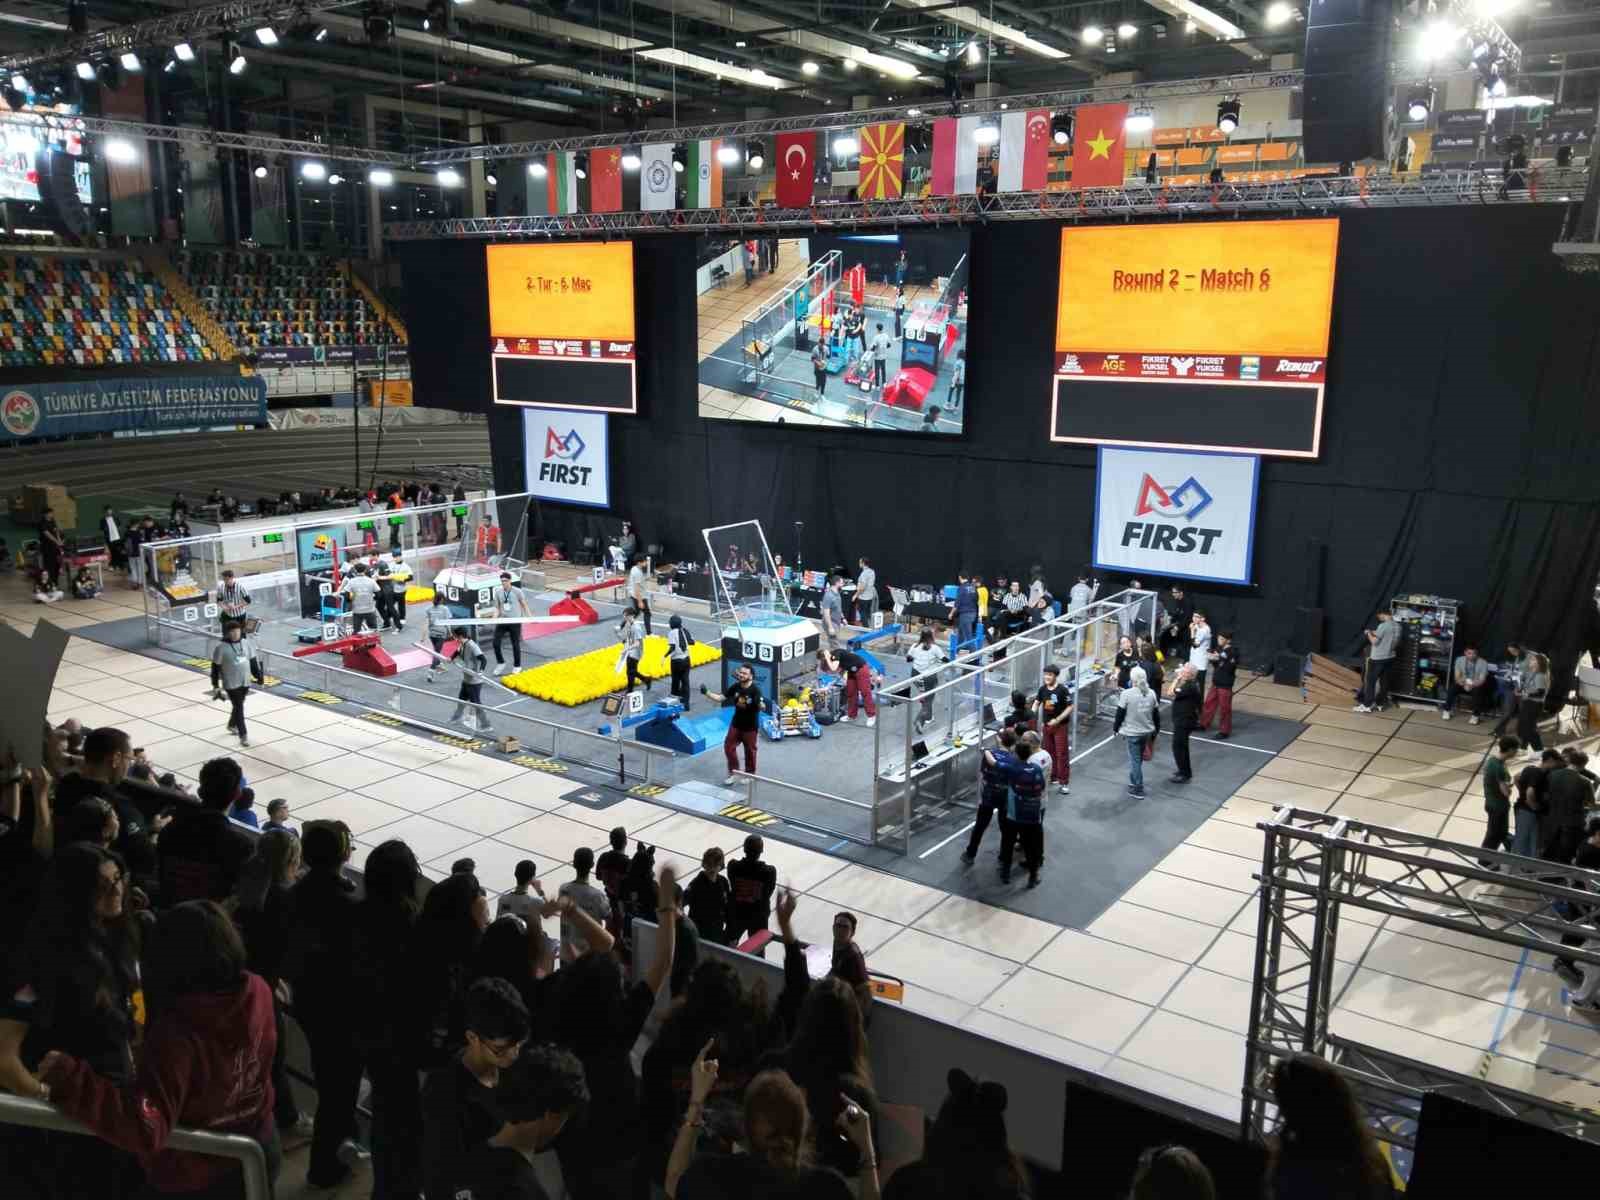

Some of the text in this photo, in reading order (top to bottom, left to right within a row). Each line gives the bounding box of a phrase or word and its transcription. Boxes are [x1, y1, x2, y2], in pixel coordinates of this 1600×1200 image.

[537, 277, 552, 288] Tur
[1113, 269, 1165, 284] Round
[1169, 269, 1179, 284] 2
[1201, 267, 1254, 284] Match
[1260, 268, 1270, 284] 6
[1102, 360, 1125, 370] AGE
[44, 389, 97, 411] TÜRKİYE
[166, 387, 258, 403] FEDERASYONU
[539, 462, 592, 486] FIRST
[1120, 521, 1223, 555] FIRST
